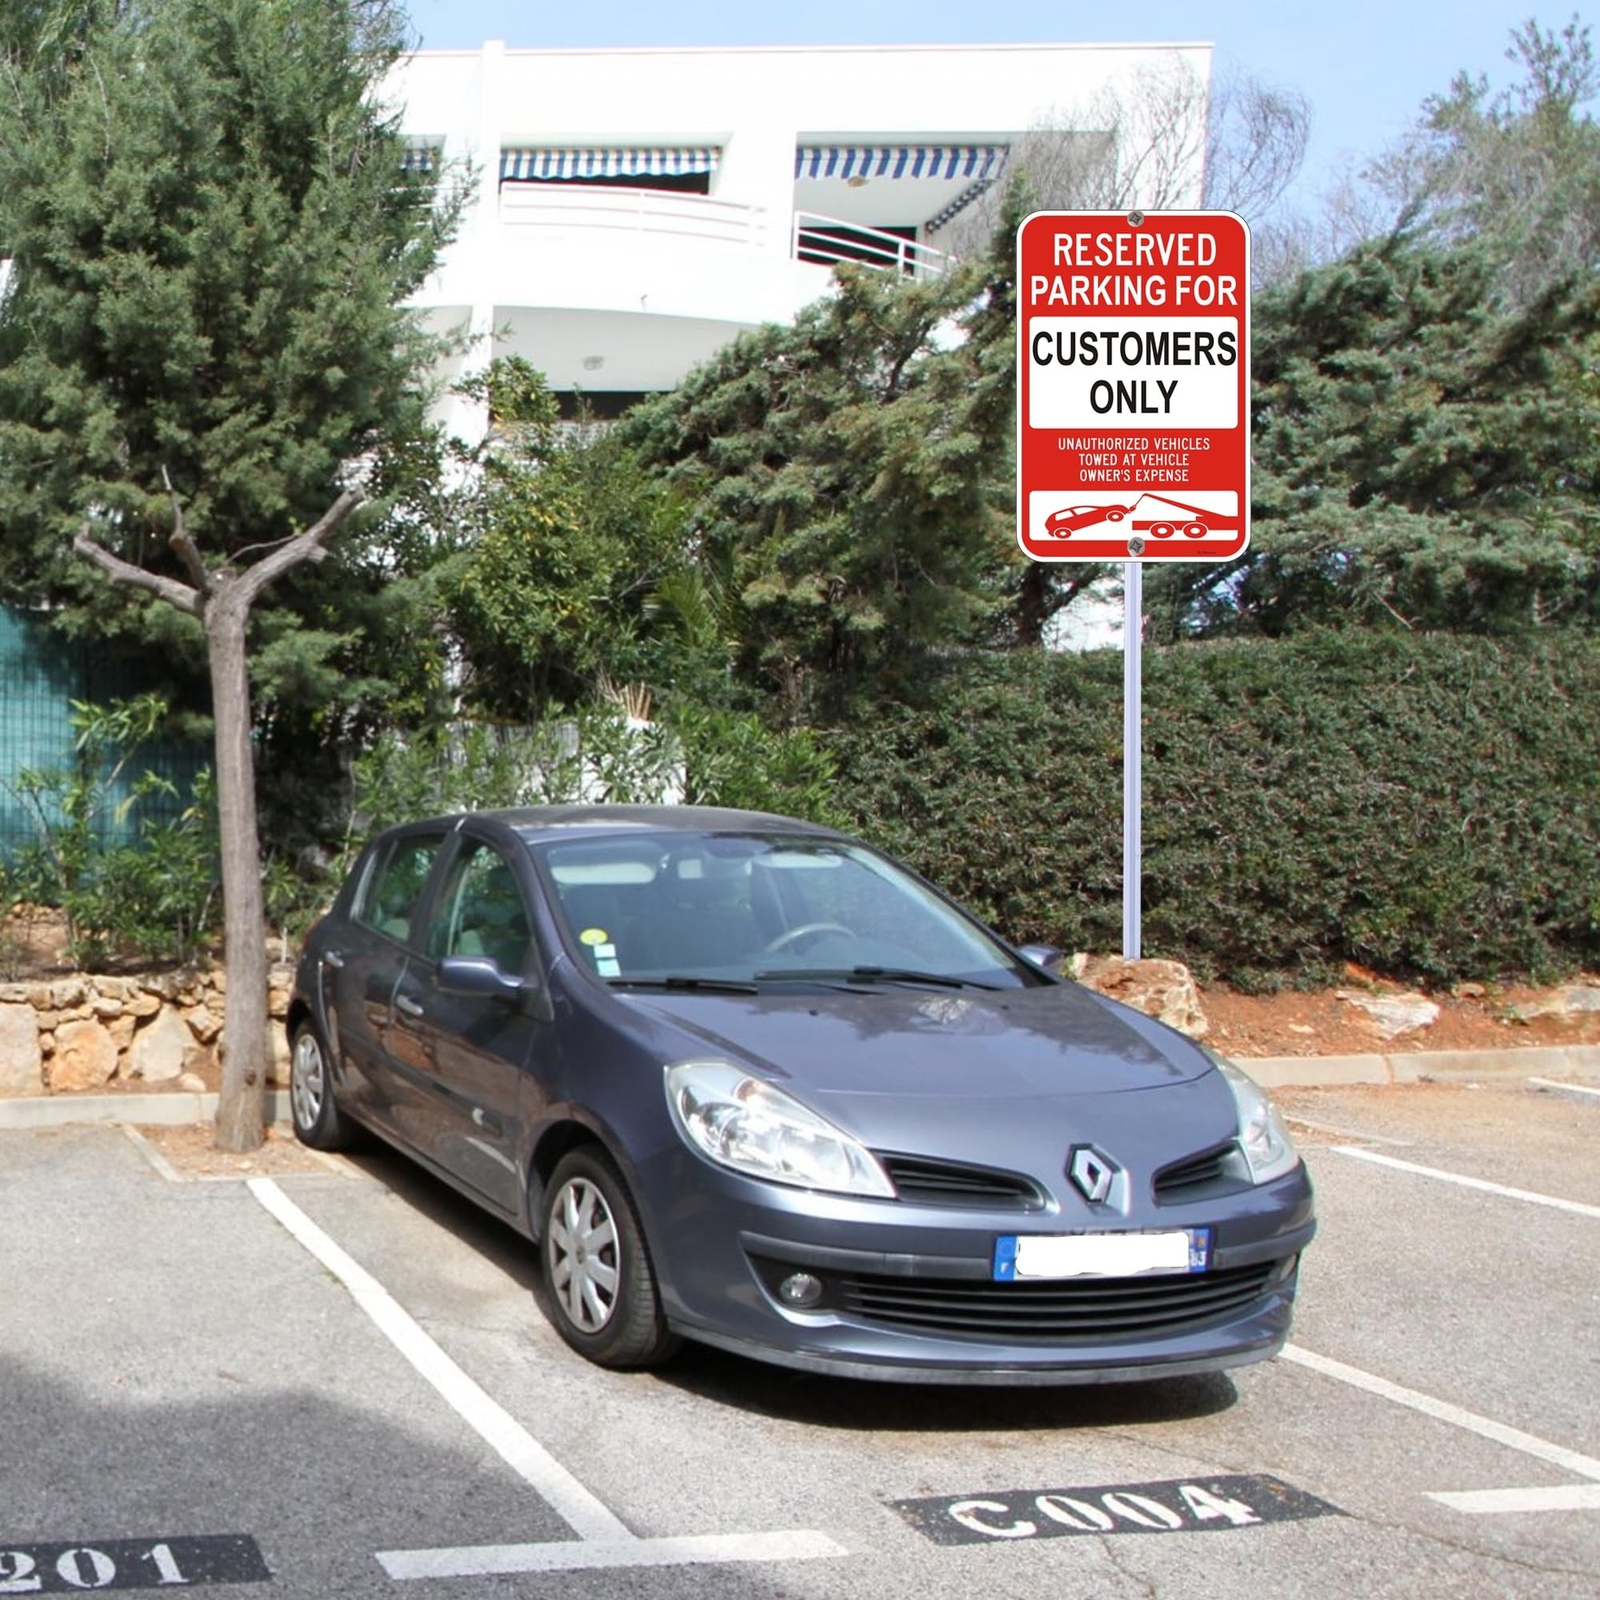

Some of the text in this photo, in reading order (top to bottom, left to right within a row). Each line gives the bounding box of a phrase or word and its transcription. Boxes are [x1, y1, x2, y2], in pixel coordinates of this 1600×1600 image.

[1054, 233, 1217, 267] RESERVED
[1031, 275, 1238, 306] PARKING FOR
[1032, 331, 1237, 366] CUSTOMERS
[1090, 380, 1179, 414] ONLY
[1058, 437, 1210, 451] UNAUTHORIZED VEHICLES
[1078, 453, 1190, 466] TOWED AT VEHICLE
[1079, 469, 1190, 482] OWNER'S EXPENSE
[0, 1544, 190, 1592] 201
